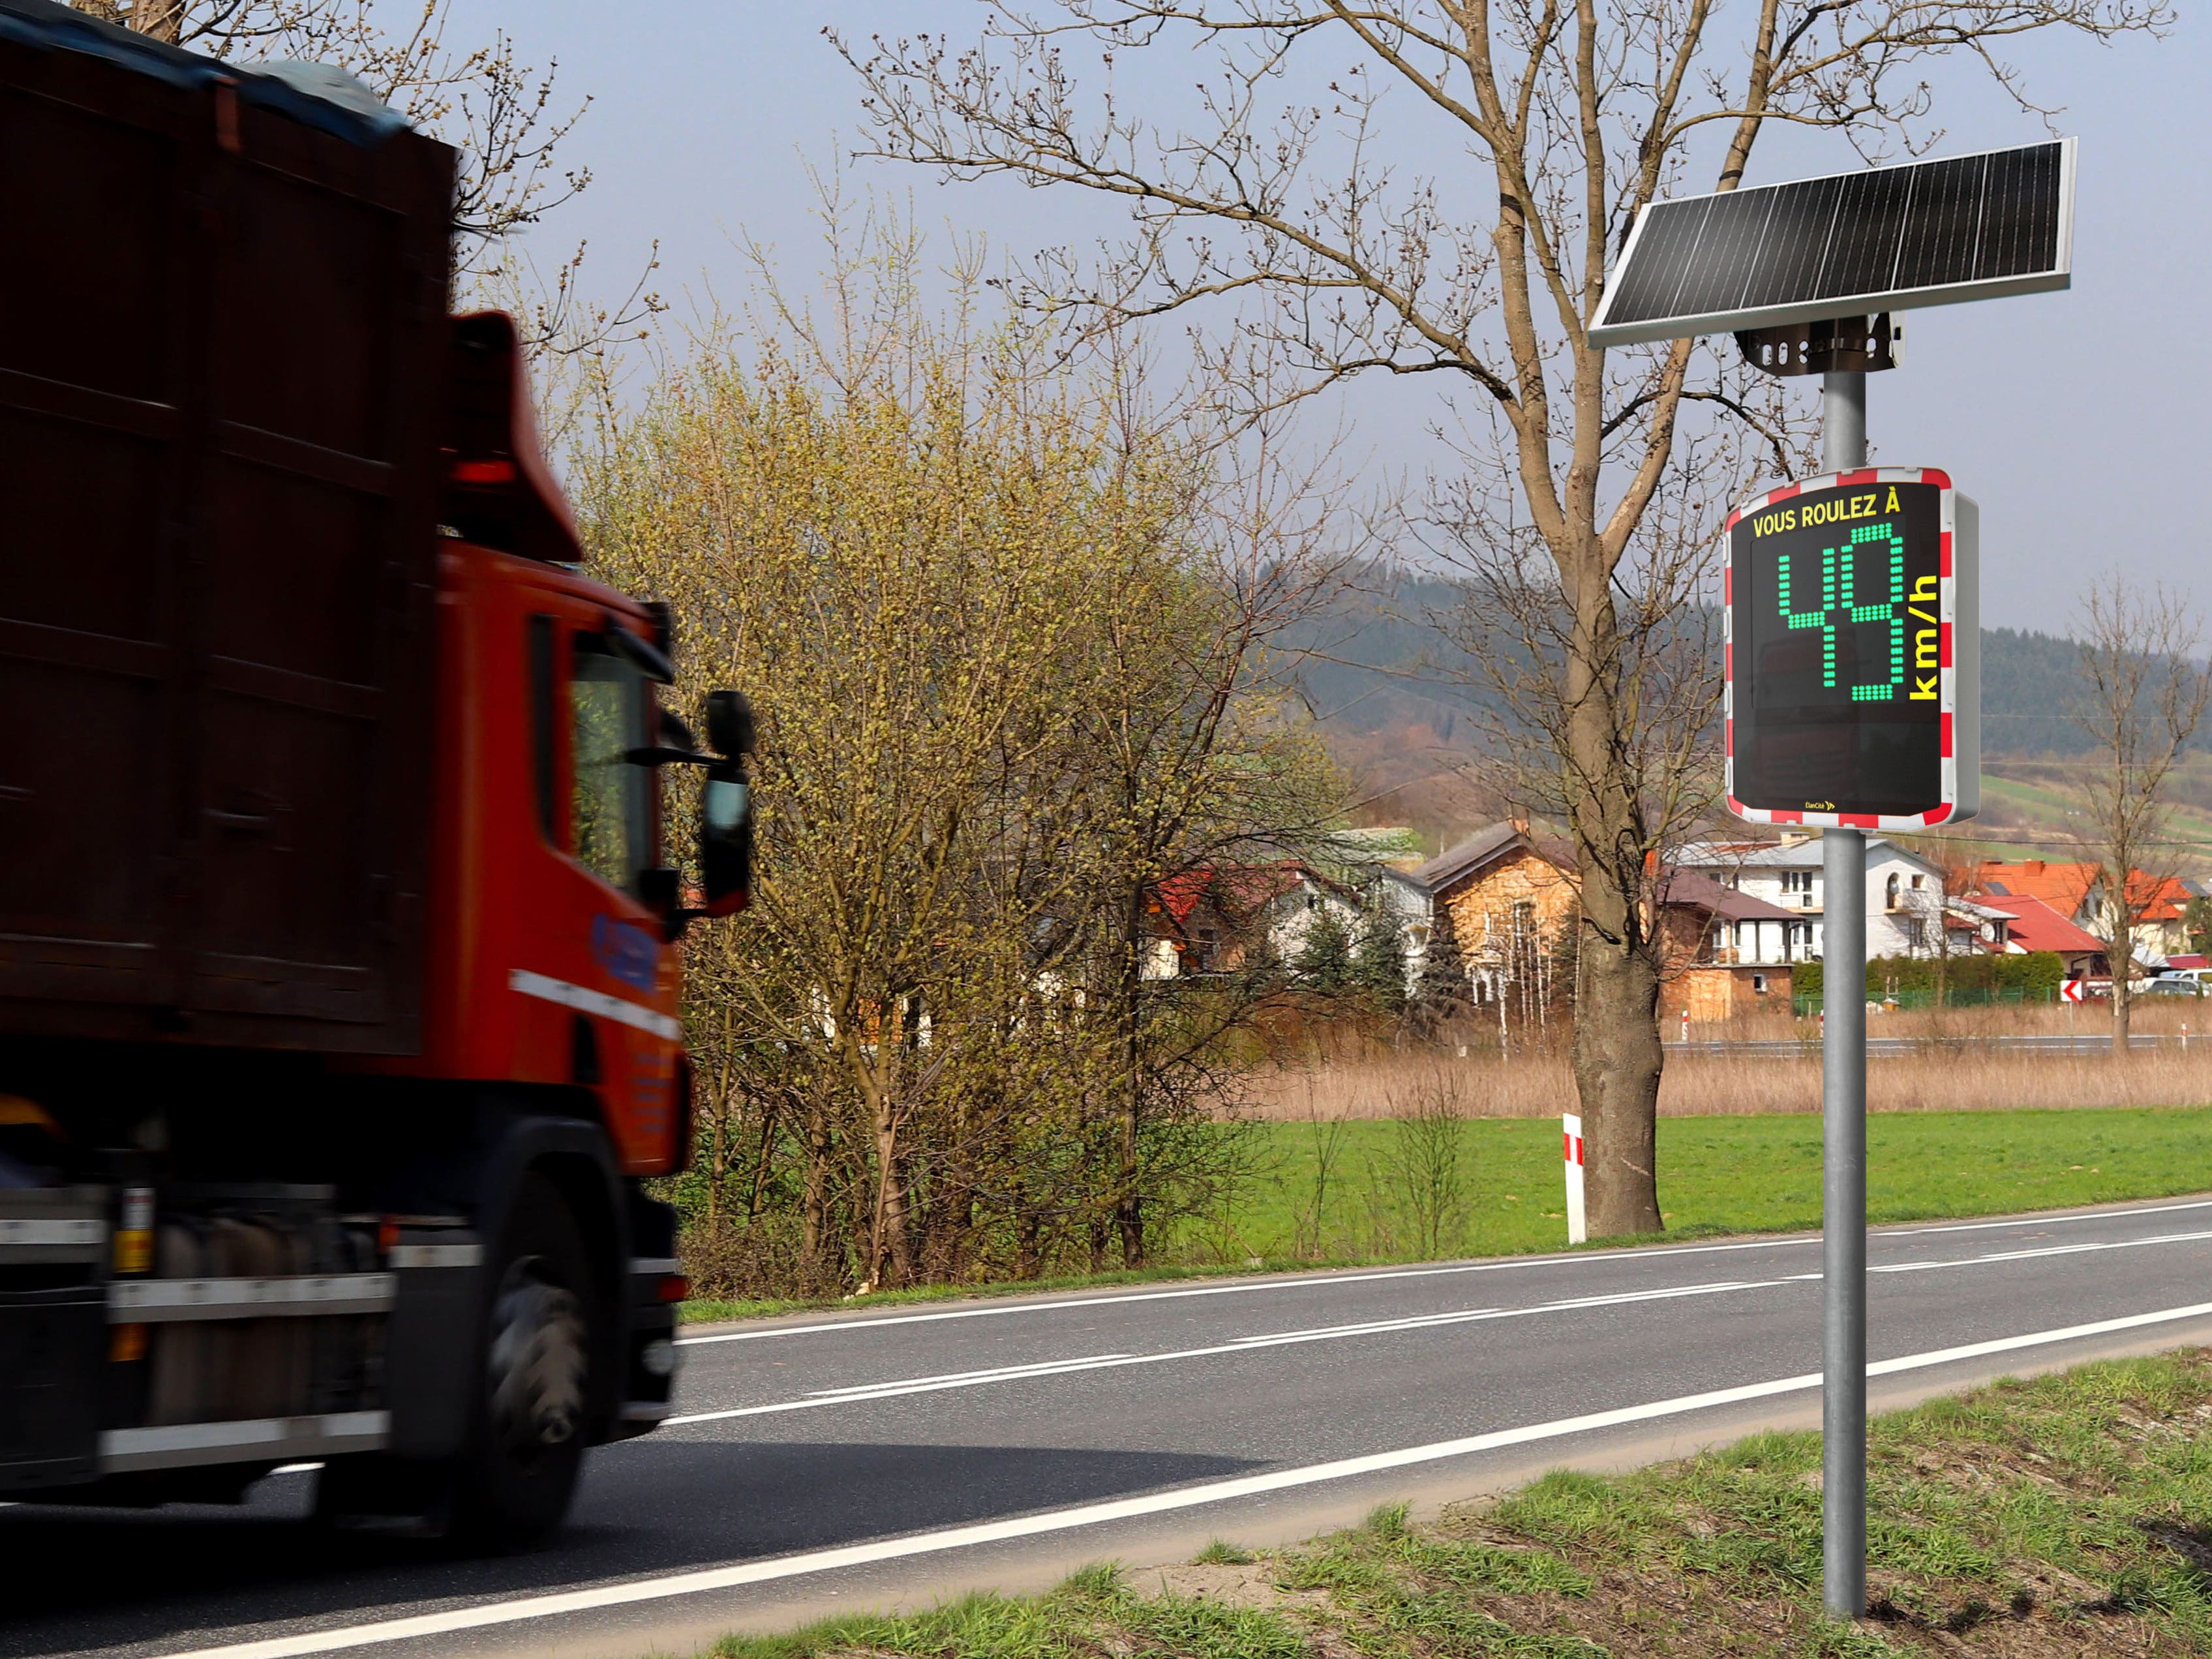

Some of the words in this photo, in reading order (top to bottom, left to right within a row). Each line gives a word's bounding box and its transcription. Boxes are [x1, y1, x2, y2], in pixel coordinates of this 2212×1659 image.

[1753, 510, 1796, 538] VOUS
[1802, 494, 1877, 528] ROULEZ
[1885, 485, 1901, 514] À
[1778, 522, 1903, 701] 49
[1908, 575, 1937, 700] km/h
